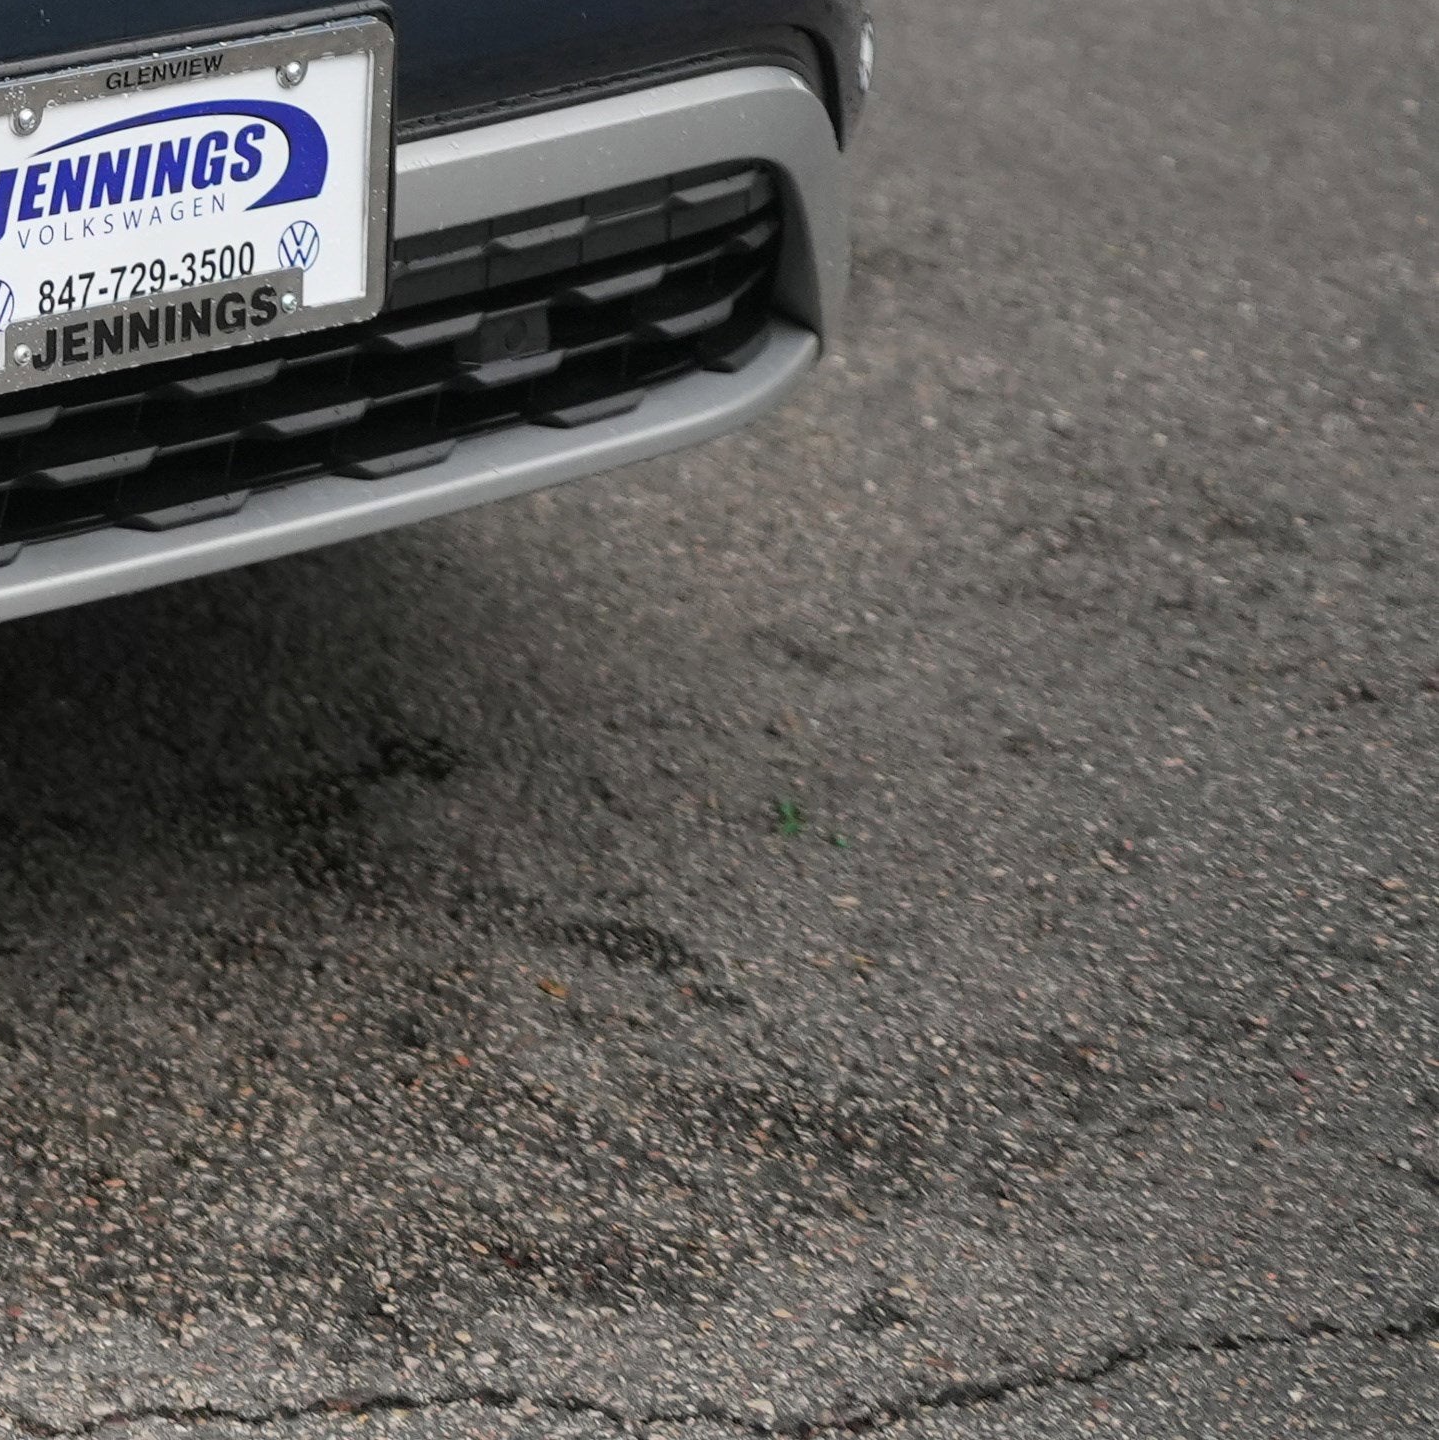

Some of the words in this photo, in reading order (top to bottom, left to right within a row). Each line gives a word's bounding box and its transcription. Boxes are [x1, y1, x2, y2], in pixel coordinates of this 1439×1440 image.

[105, 53, 225, 91] GLENVIEW
[17, 192, 226, 249] VOLKSWAGEN
[38, 241, 256, 316] 847-729-3500
[32, 285, 279, 372] JENNINGS
